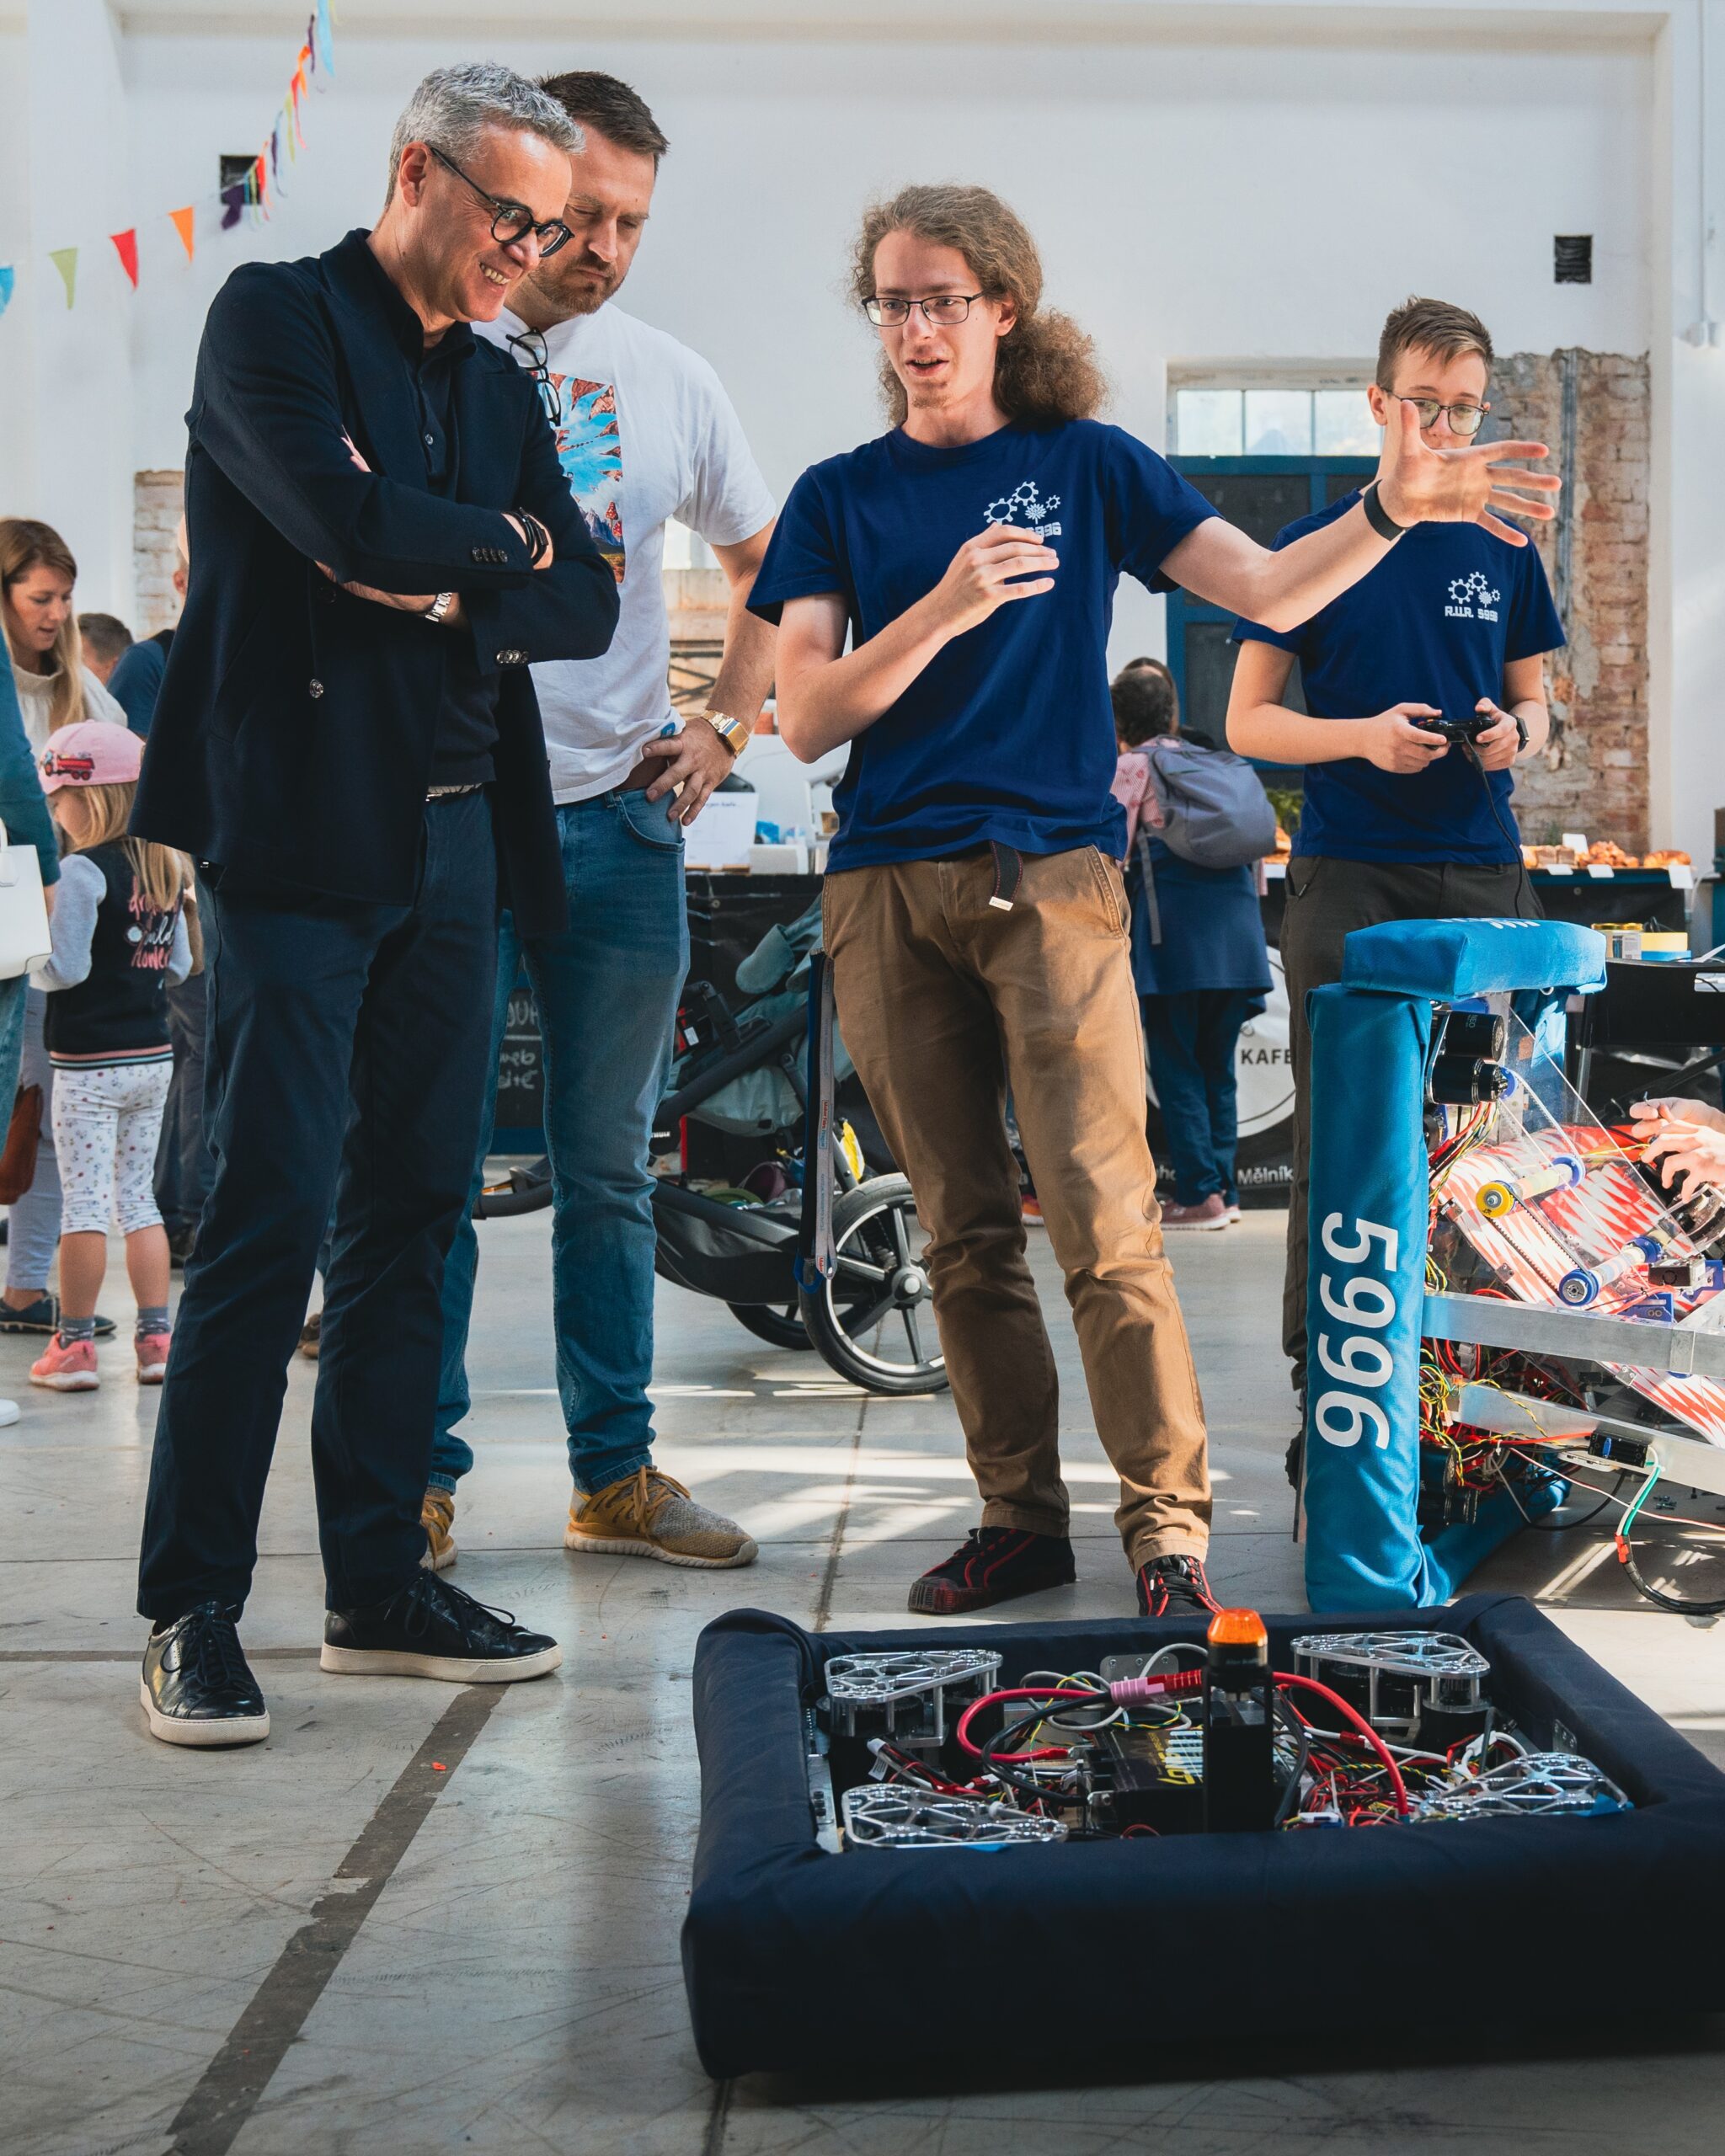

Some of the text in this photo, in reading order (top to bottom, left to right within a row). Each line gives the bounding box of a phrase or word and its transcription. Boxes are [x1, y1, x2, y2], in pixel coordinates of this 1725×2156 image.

[1025, 522, 1062, 539] 996
[1445, 606, 1474, 618] R.U.R.
[1237, 1165, 1295, 1185] Mělník
[1316, 1212, 1398, 1449] 5996
